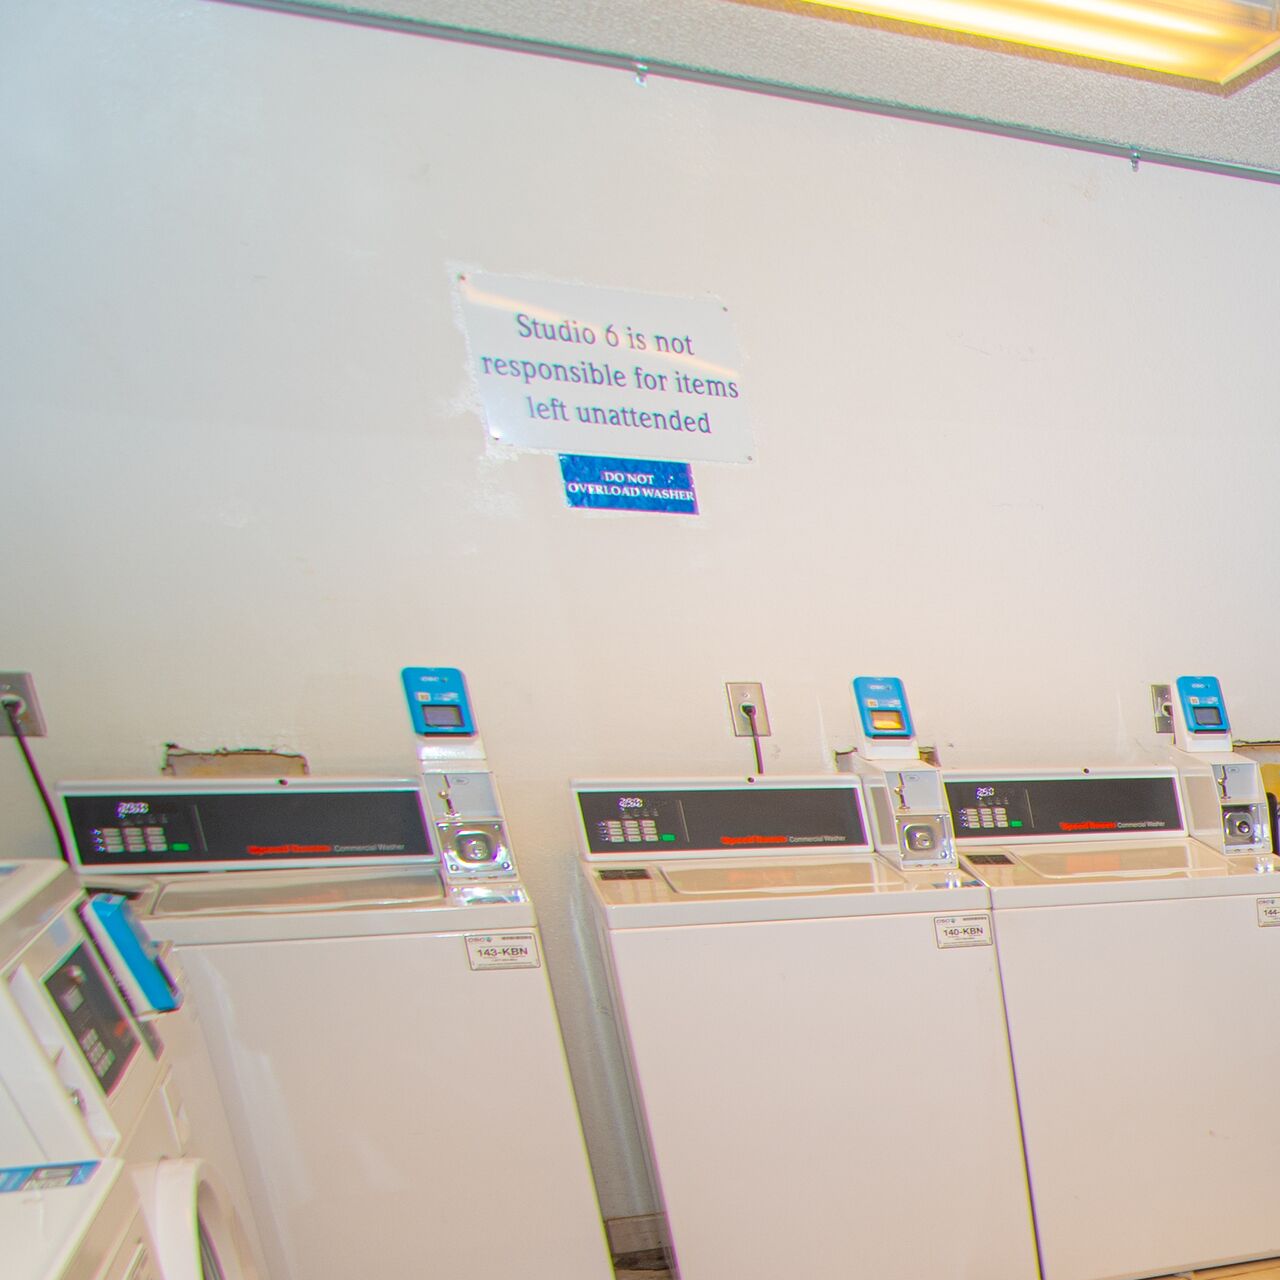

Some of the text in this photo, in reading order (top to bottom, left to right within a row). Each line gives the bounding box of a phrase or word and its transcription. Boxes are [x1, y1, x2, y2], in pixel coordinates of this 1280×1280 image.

[515, 313, 696, 356] Studio 6 is not
[480, 354, 740, 399] responsible for items
[526, 395, 713, 434] left unattended
[603, 471, 655, 486] DO NOT
[567, 482, 696, 502] OVERLOAD WASHER
[943, 927, 984, 937] 140-KBN
[477, 946, 529, 957] 143-KBN
